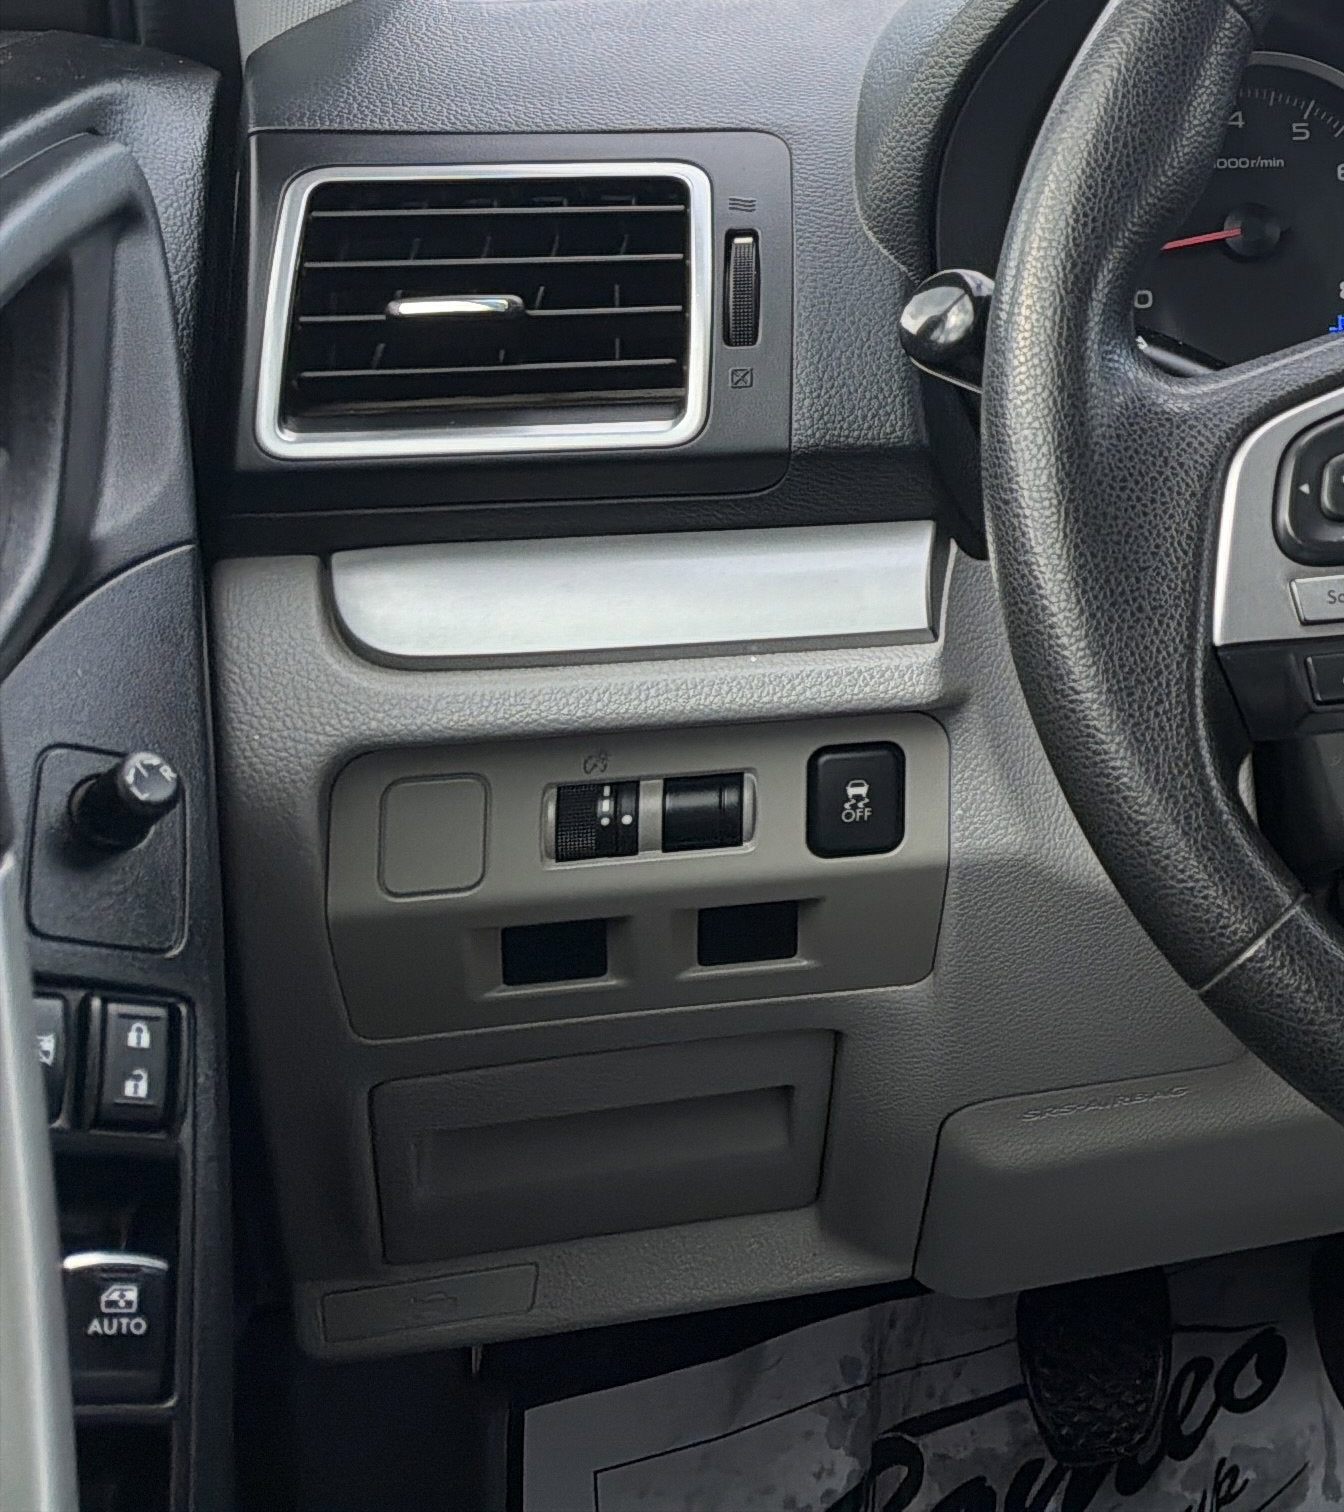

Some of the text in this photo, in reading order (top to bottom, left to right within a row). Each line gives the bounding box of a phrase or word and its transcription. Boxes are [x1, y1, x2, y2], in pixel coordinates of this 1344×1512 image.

[1228, 110, 1245, 128] 4
[1292, 122, 1310, 140] 5
[1134, 290, 1153, 308] 0
[841, 808, 872, 823] OFF
[87, 1317, 147, 1336] AUTO
